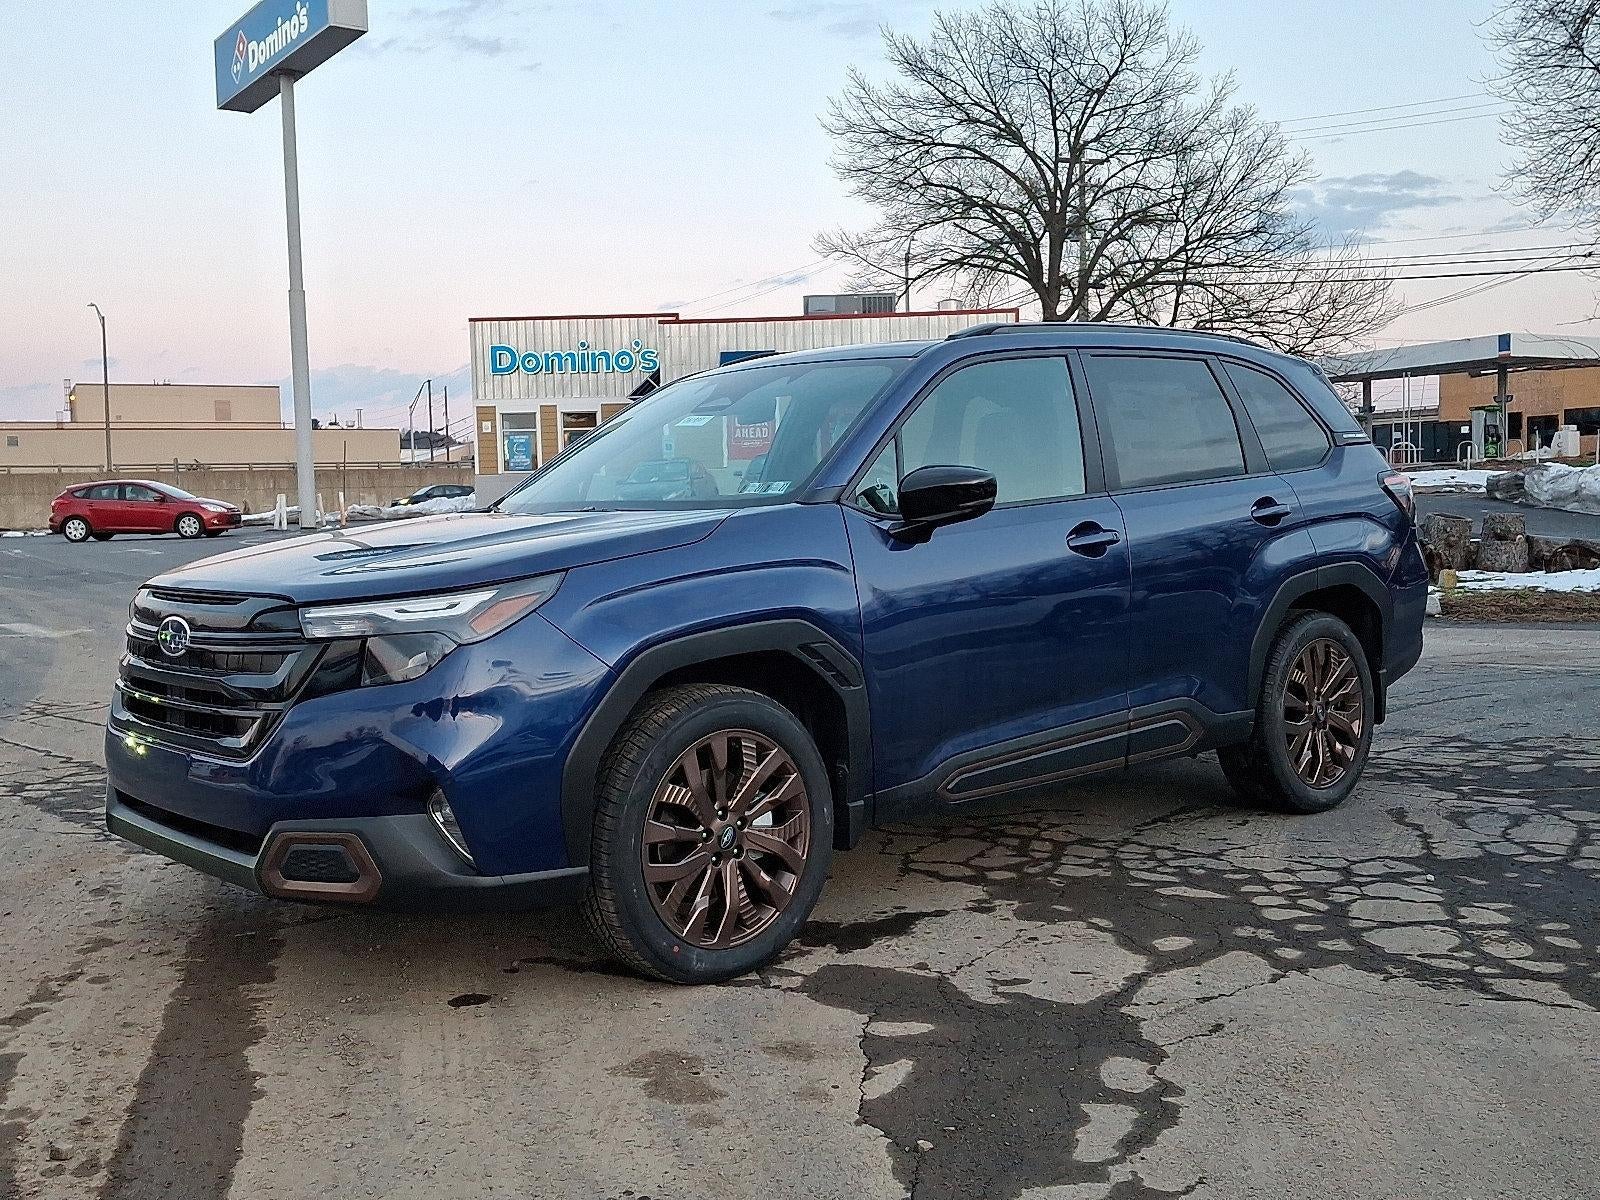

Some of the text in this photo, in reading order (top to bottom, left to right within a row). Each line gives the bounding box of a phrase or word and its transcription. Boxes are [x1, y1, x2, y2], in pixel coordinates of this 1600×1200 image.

[248, 1, 309, 73] Domino's
[489, 339, 660, 375] Domino's
[734, 427, 769, 438] AHEAD
